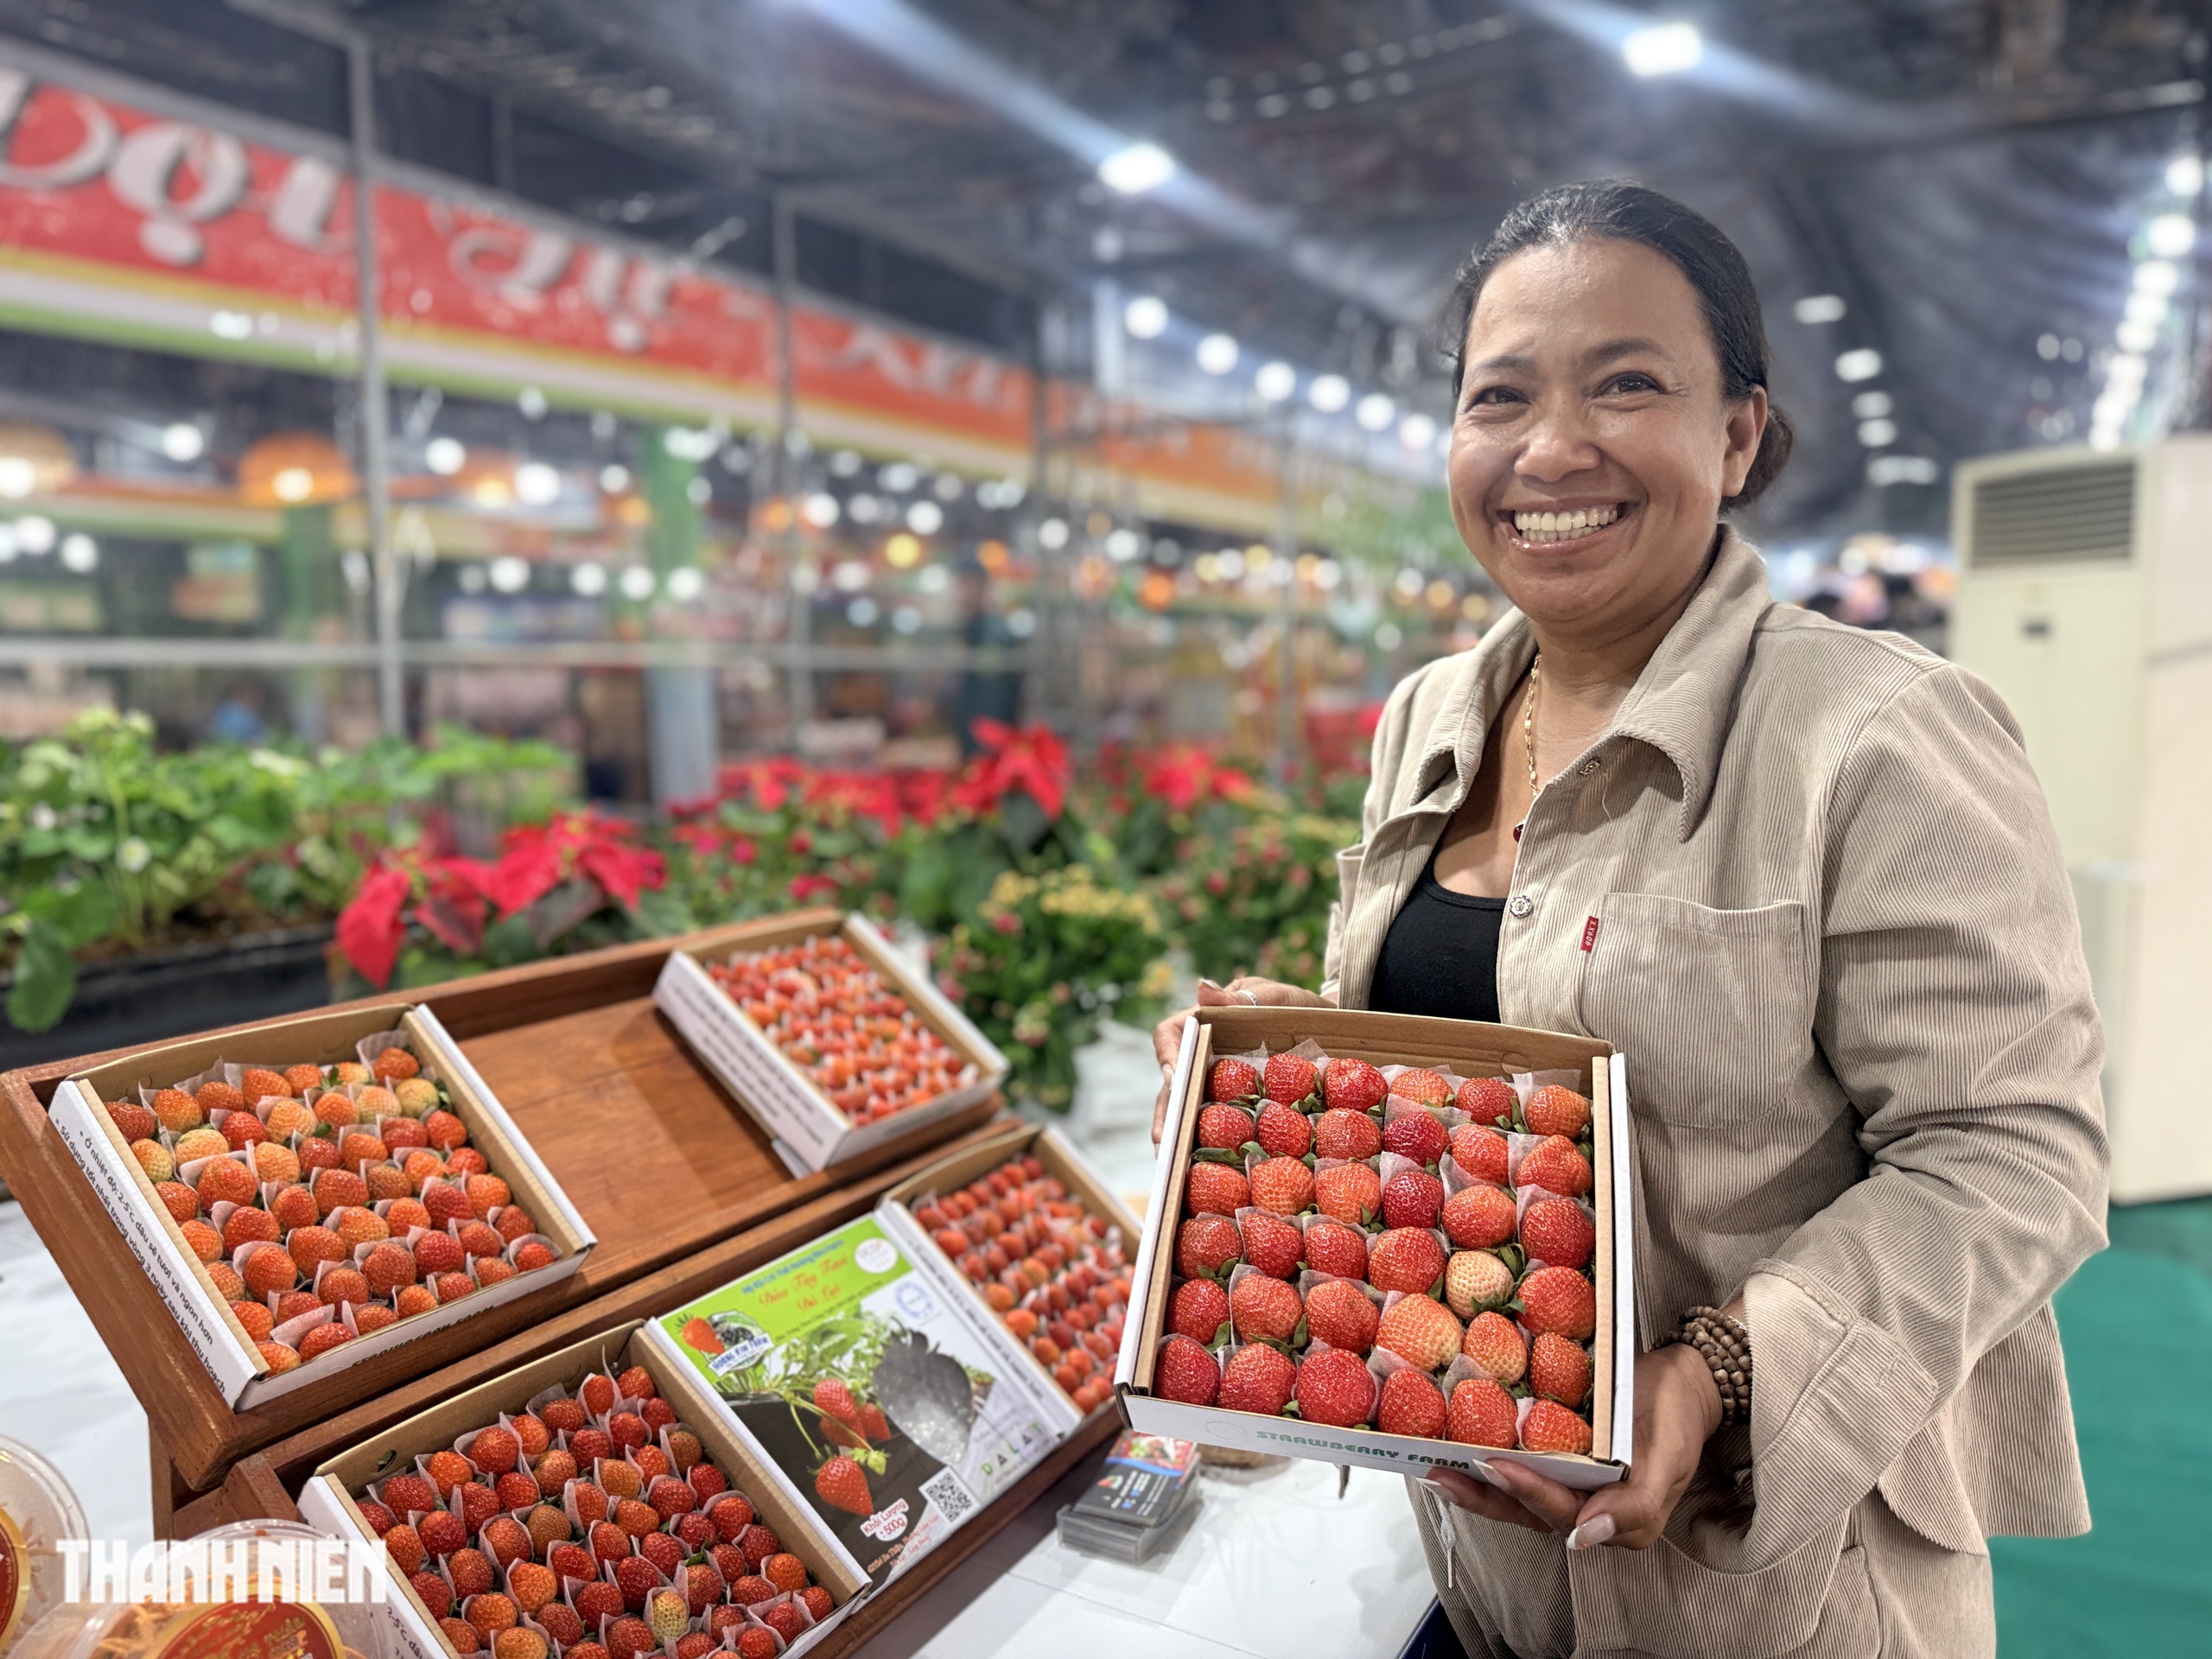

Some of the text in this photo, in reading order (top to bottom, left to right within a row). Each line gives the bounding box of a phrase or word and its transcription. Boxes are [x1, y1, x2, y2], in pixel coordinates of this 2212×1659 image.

[69, 1141, 86, 1170] dụng
[86, 1166, 96, 1185] tốt
[95, 1184, 111, 1209] nhất
[110, 1207, 129, 1239] trong
[128, 1236, 147, 1266] vòng
[145, 1262, 152, 1273] 3
[150, 1271, 168, 1300] ngày
[167, 1299, 181, 1320] sau
[180, 1318, 193, 1339] khi
[191, 1338, 205, 1358] thu
[90, 1148, 108, 1178] nhiệt
[135, 1222, 149, 1243] dâu
[156, 1254, 172, 1279] tươi
[171, 1276, 181, 1293] và
[179, 1292, 200, 1323] ngon
[198, 1319, 214, 1345] hơn
[1255, 1430, 1470, 1470] STRAWBERRY FARM
[862, 1501, 907, 1535] Khối Lượng
[883, 1517, 906, 1535] 500g
